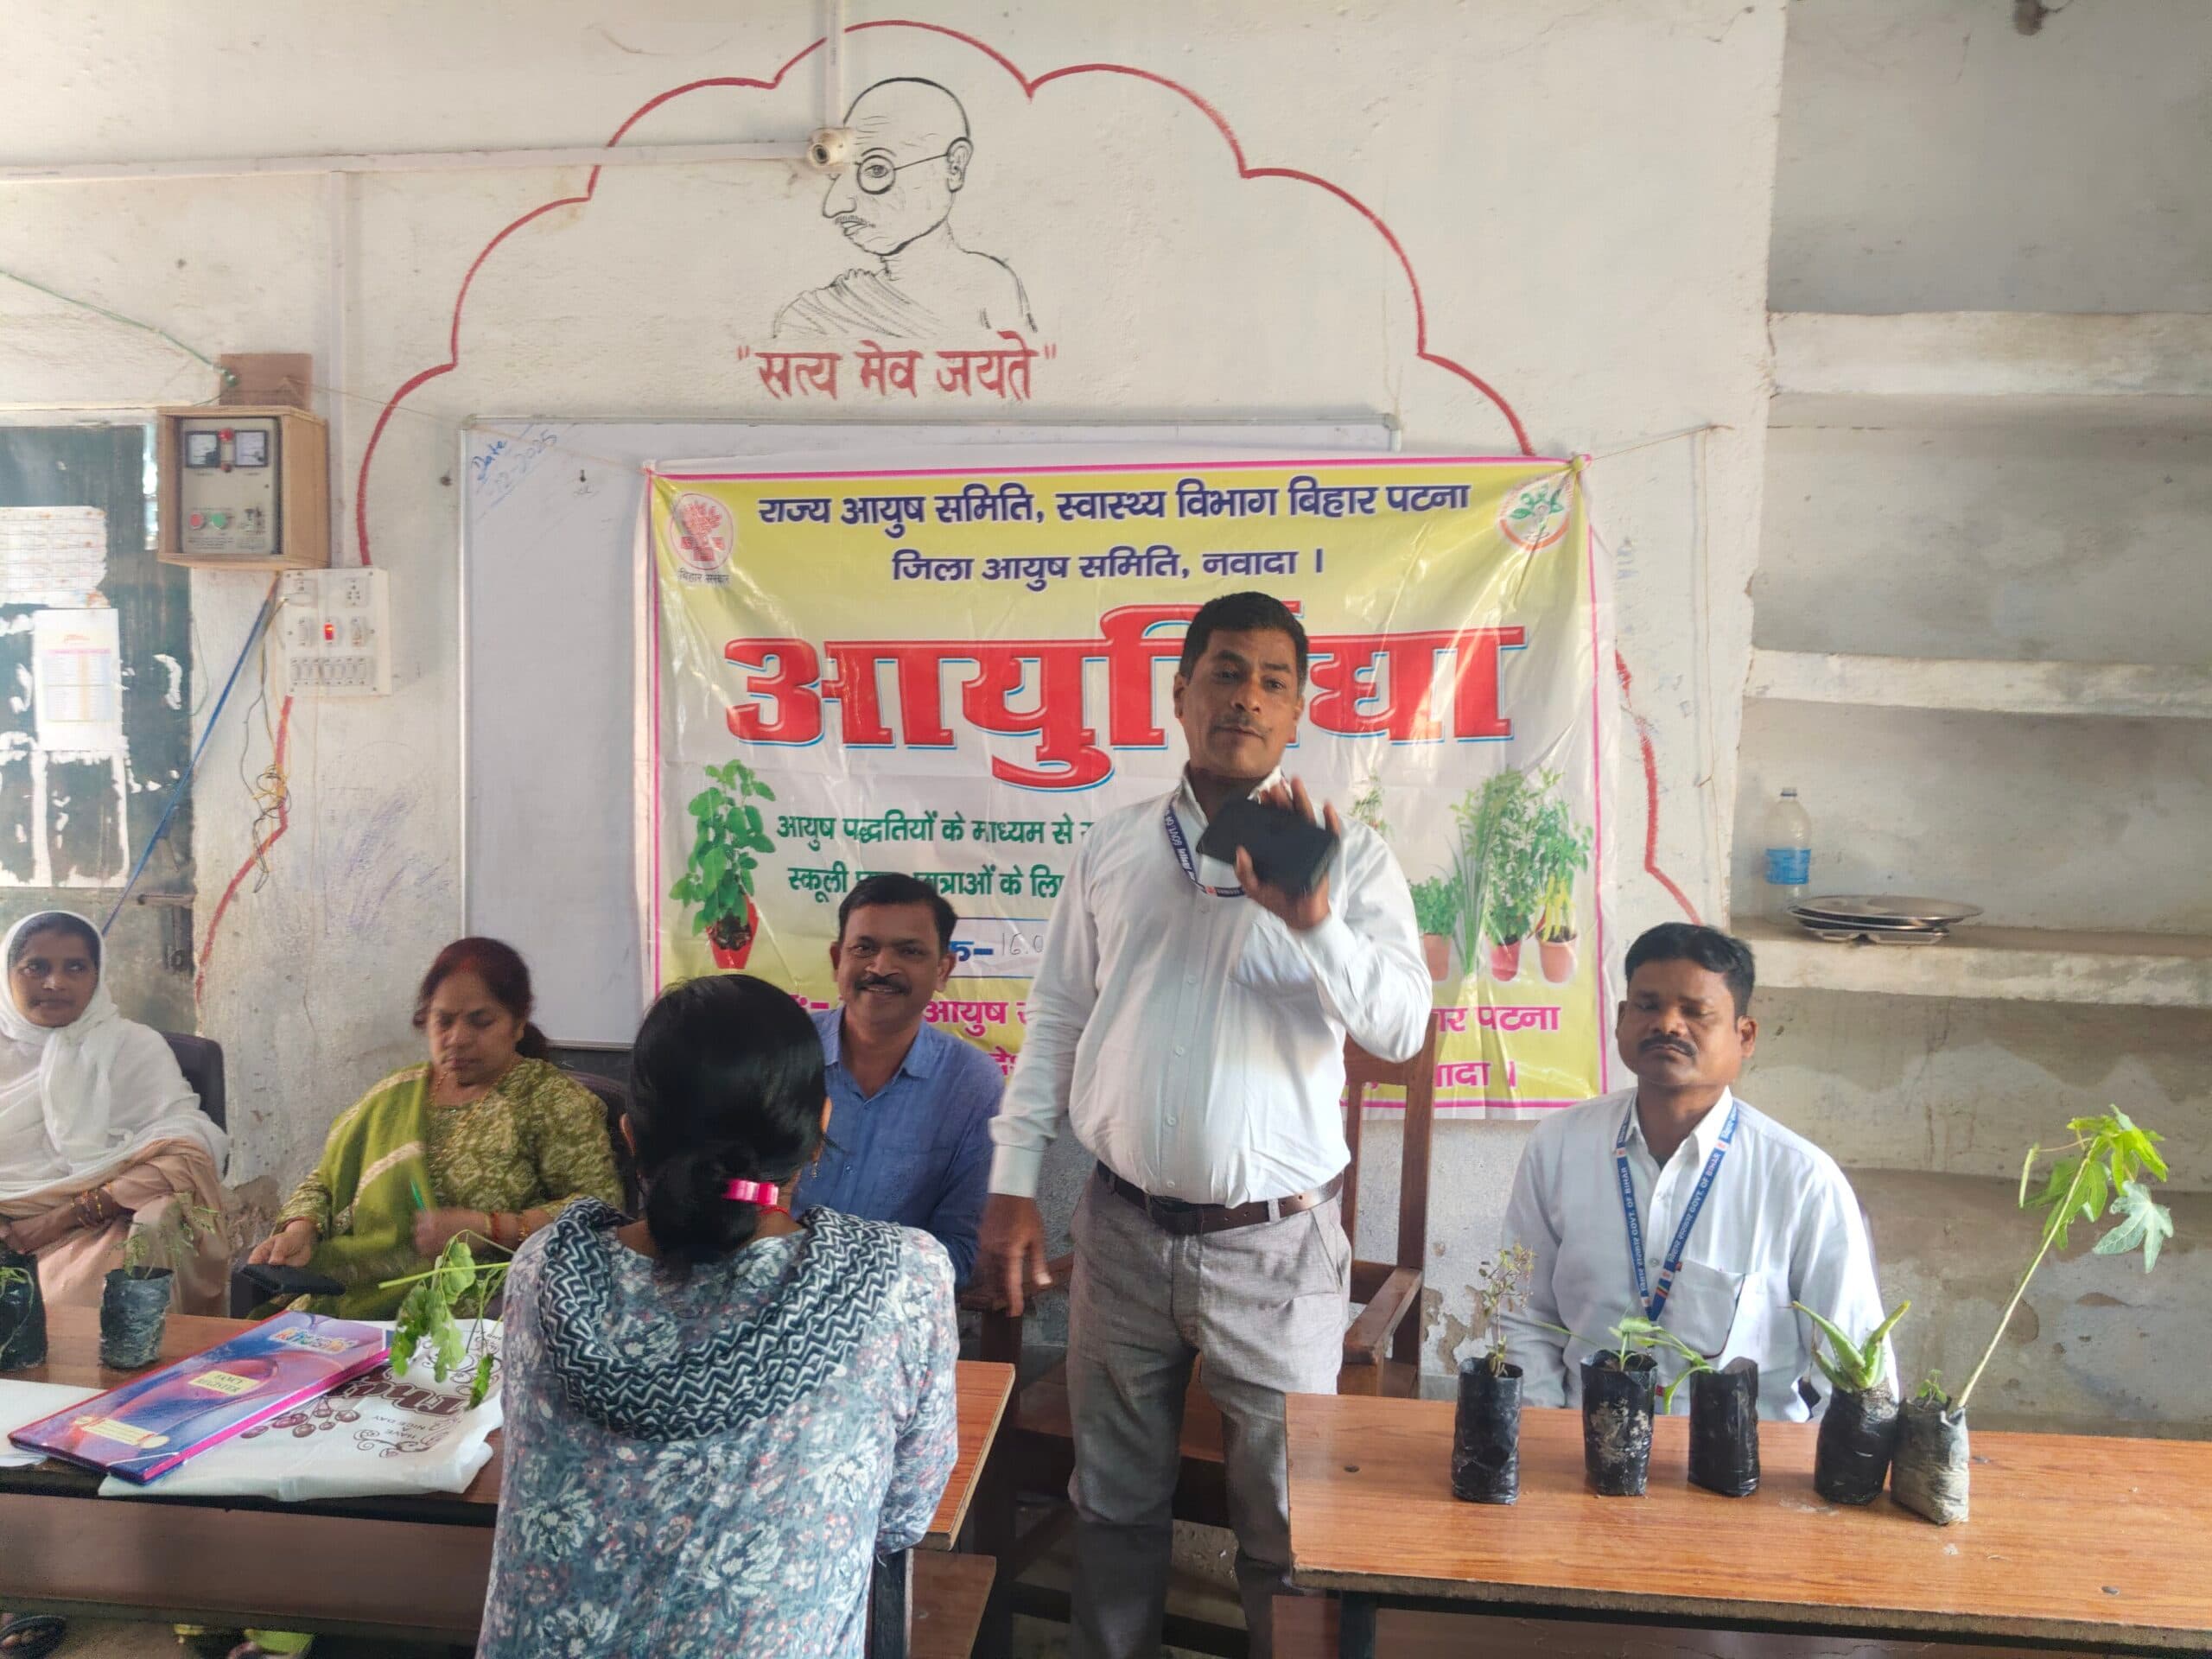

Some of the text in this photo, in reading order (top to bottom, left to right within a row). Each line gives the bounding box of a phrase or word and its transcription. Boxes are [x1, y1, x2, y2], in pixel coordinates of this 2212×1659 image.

[854, 340, 925, 398] मेव
[759, 499, 831, 523] राज्य
[841, 497, 925, 538] आयुष
[934, 483, 1045, 524] समिति,
[1056, 491, 1166, 519] स्वास्थ्य
[1177, 478, 1279, 517] विभाग
[1287, 475, 1379, 518] बिहार
[1386, 485, 1471, 512] पटना
[892, 550, 974, 581] जिला
[982, 556, 1070, 592] आयुष
[1079, 545, 1190, 578] समिति,
[1203, 551, 1298, 575] नवादा
[777, 816, 836, 851] आयुष
[842, 809, 938, 843] पद्धतियों
[941, 810, 966, 842] के
[971, 819, 1045, 844] माध्यम
[1051, 812, 1074, 844] से
[787, 861, 849, 903] स्कूली
[999, 865, 1024, 896] के
[925, 1001, 1008, 1037] आयुष
[1477, 1007, 1560, 1031] पटना
[1620, 1167, 1633, 1194] BIHAR
[1700, 1175, 1709, 1187] OF
[1707, 1153, 1721, 1176] BIHAR
[1625, 1196, 1634, 1208] OF
